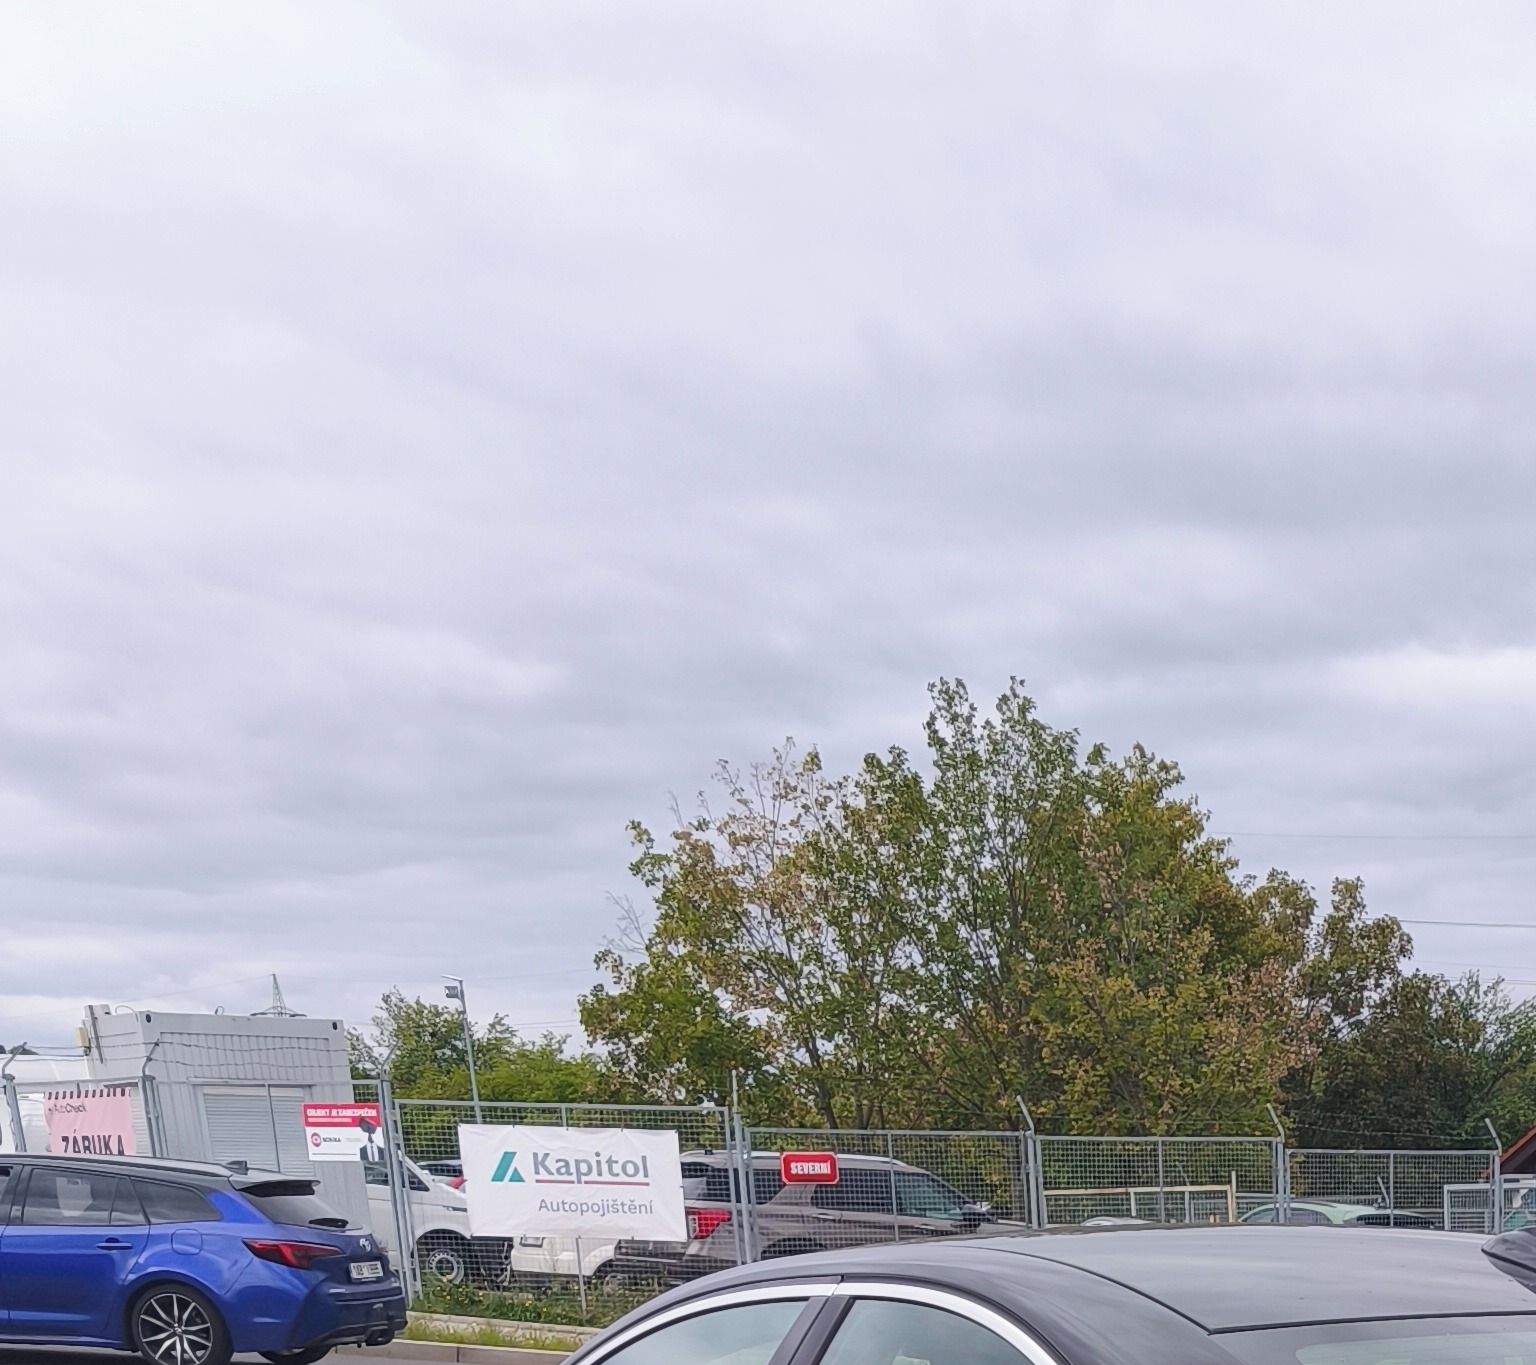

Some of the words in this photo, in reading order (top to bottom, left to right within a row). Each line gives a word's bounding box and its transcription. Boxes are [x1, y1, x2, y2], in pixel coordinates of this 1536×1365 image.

[61, 1128, 125, 1156] ZÁRUKA
[532, 1151, 650, 1185] Kapitol
[790, 1159, 831, 1175] SEVERNÍ
[538, 1198, 654, 1217] Autopojištění
